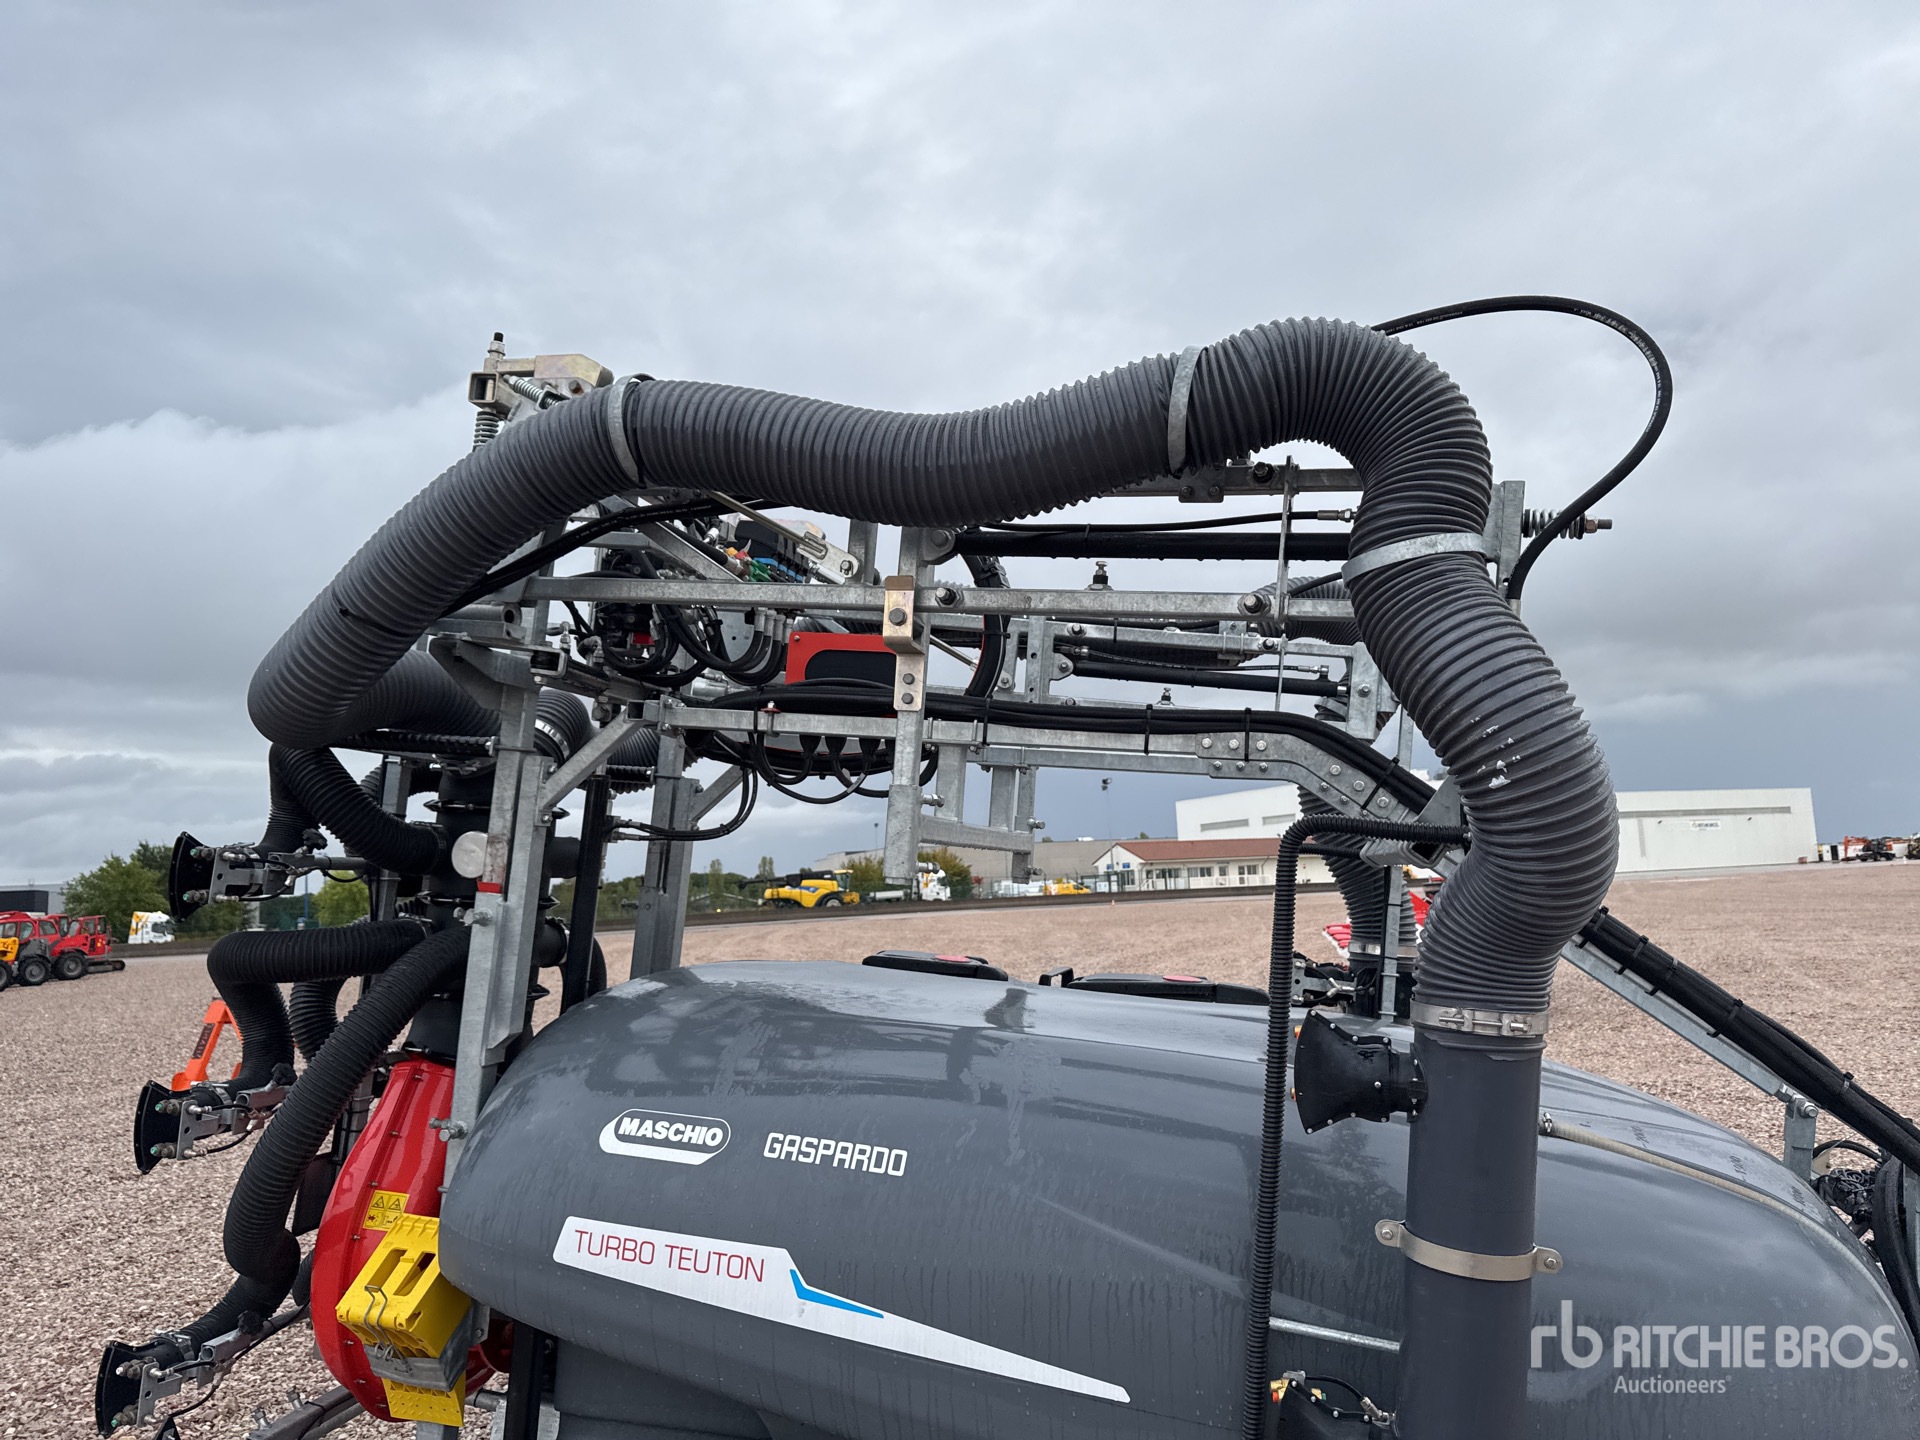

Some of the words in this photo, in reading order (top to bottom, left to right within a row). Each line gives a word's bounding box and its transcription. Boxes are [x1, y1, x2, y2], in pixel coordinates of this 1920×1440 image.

[618, 1117, 723, 1147] MASCHIO
[763, 1132, 908, 1177] GASPARDO
[575, 1230, 655, 1265] TURBO
[664, 1244, 764, 1283] TEUTON
